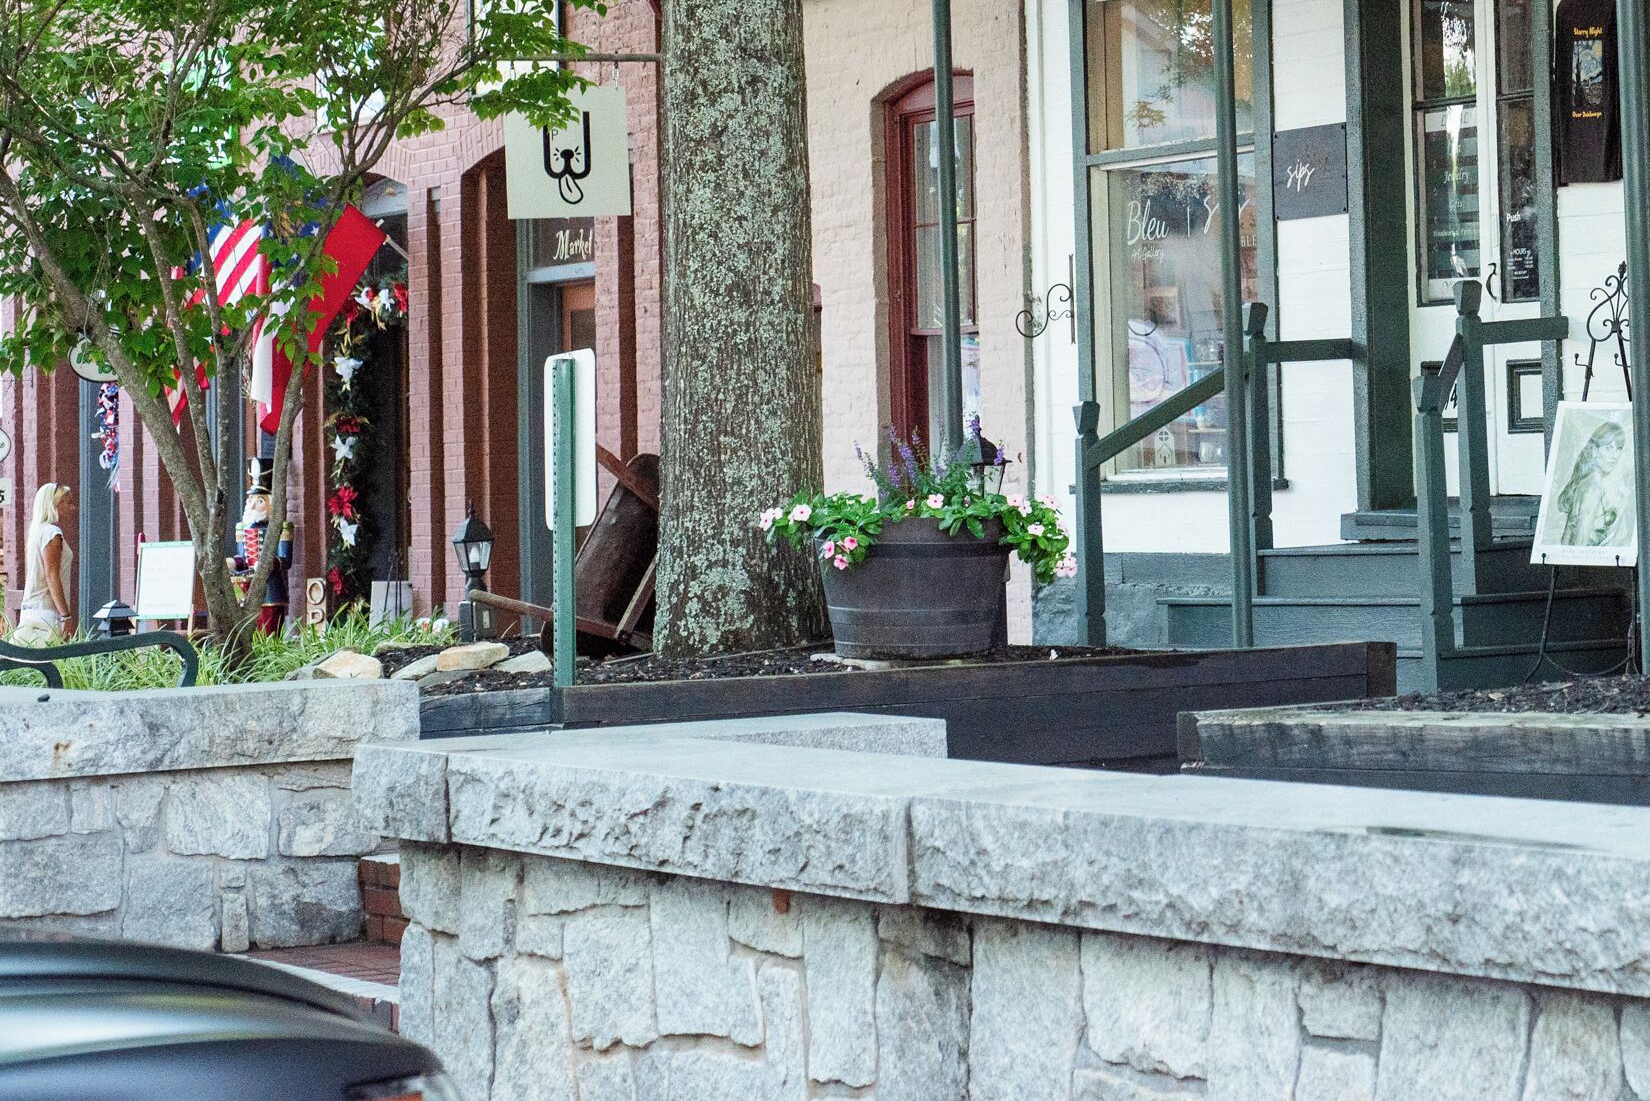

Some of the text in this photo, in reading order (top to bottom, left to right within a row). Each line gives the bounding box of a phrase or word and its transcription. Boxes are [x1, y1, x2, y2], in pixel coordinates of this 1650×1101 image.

[1287, 158, 1315, 192] sips
[1127, 198, 1170, 245] Bleu
[1506, 210, 1521, 223] Push
[553, 228, 593, 261] Market
